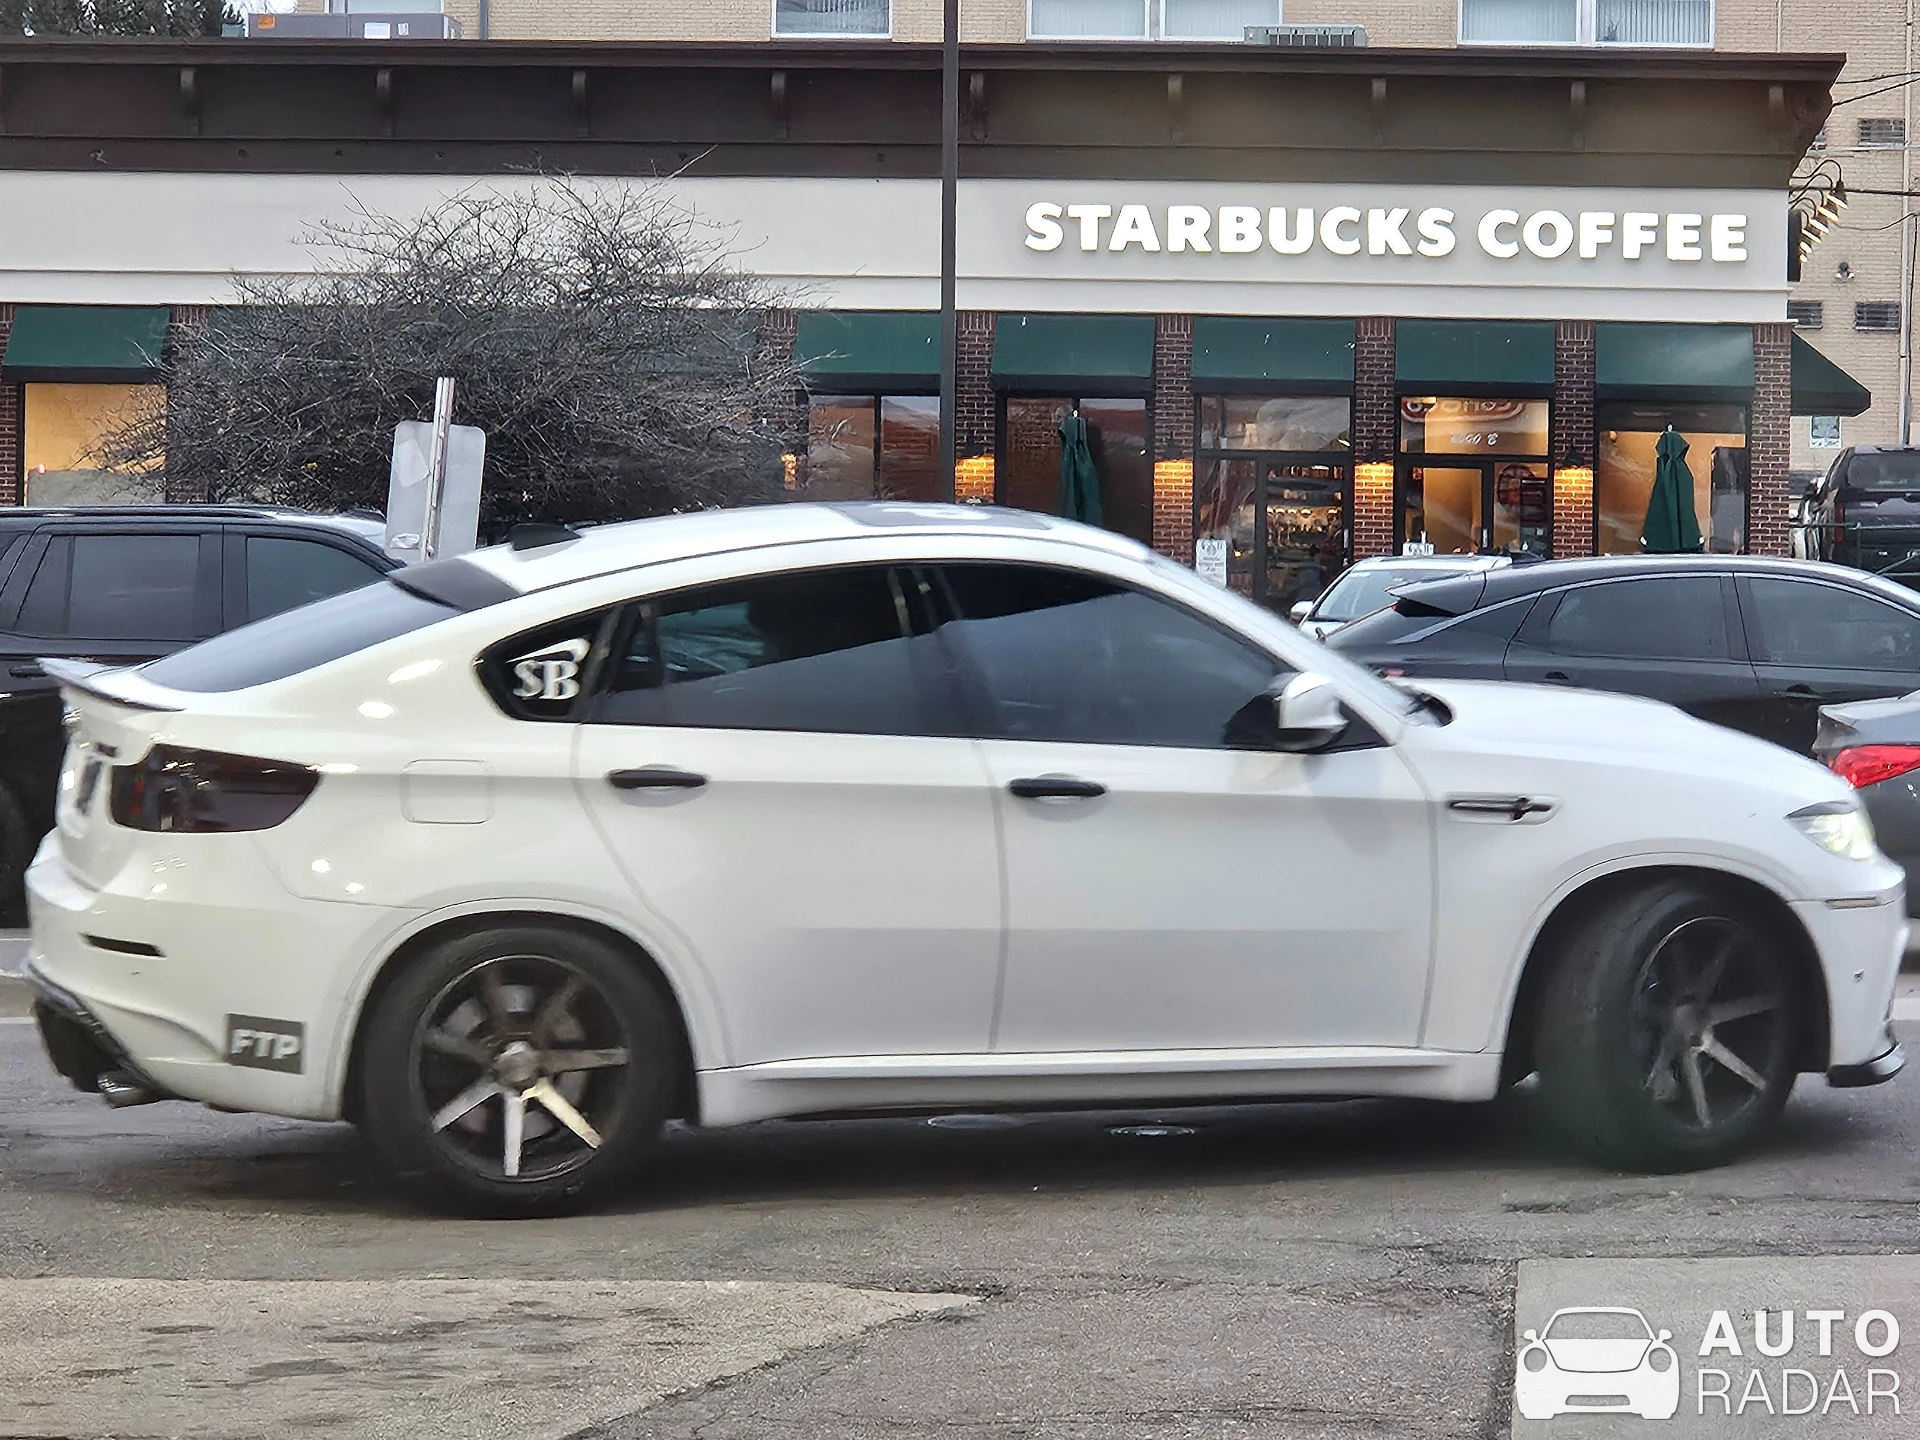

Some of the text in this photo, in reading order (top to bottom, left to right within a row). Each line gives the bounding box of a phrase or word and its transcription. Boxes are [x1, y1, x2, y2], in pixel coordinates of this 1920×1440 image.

[1024, 202, 1748, 261] STARBUCKS COFFEE
[513, 660, 580, 699] SB
[230, 1029, 299, 1059] FTP
